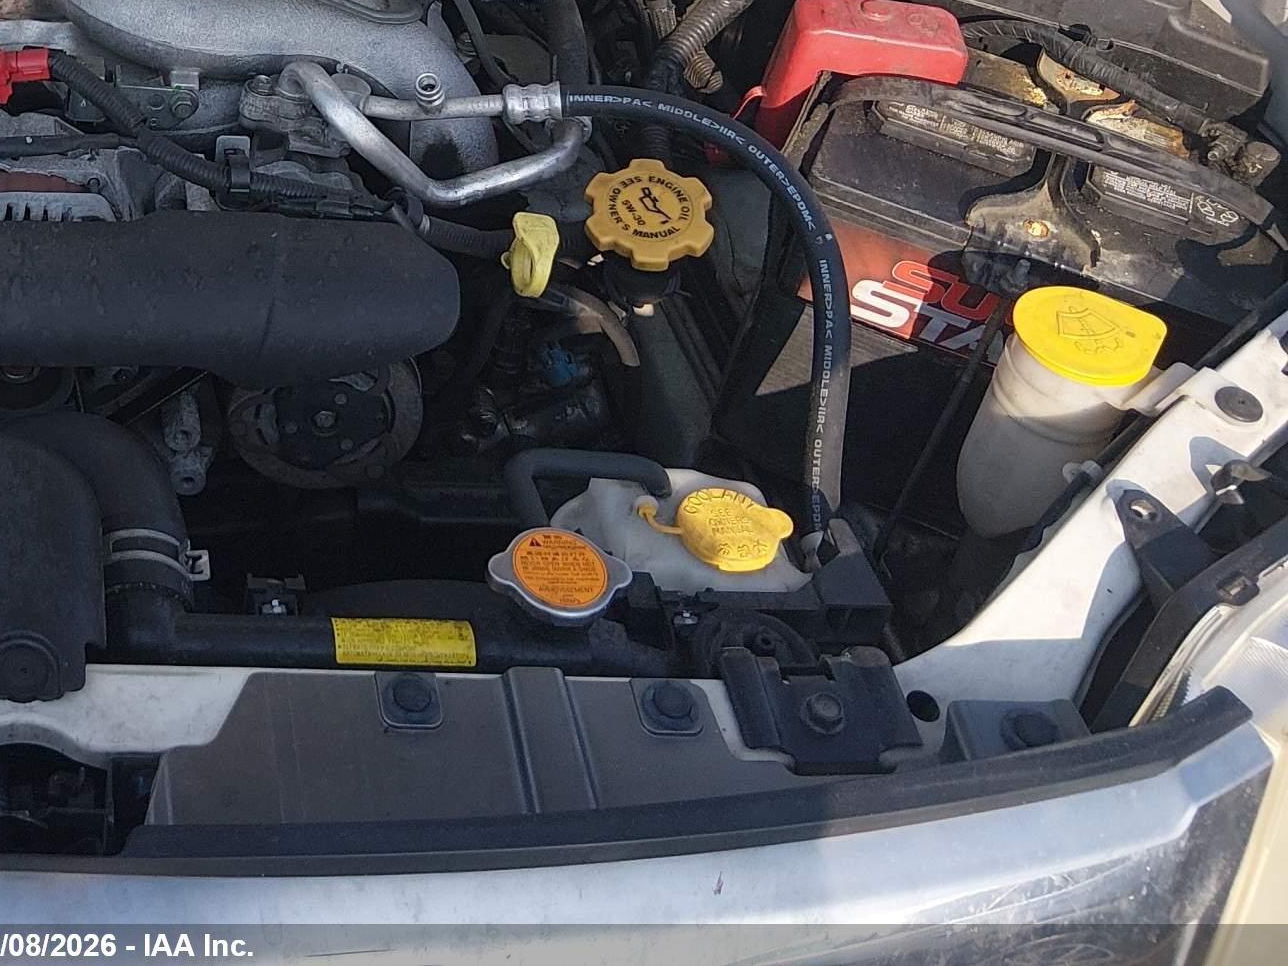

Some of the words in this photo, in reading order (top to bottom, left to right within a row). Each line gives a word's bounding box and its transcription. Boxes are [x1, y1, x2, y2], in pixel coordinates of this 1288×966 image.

[620, 176, 642, 189] SEE
[648, 175, 689, 203] ENGINE
[677, 205, 691, 221] OIL
[748, 144, 816, 231] OUTER>EPDM<
[608, 187, 631, 231] OWNER'S
[621, 199, 647, 226] 5W-30
[632, 225, 681, 239] MANUAL
[892, 260, 1015, 326] SU
